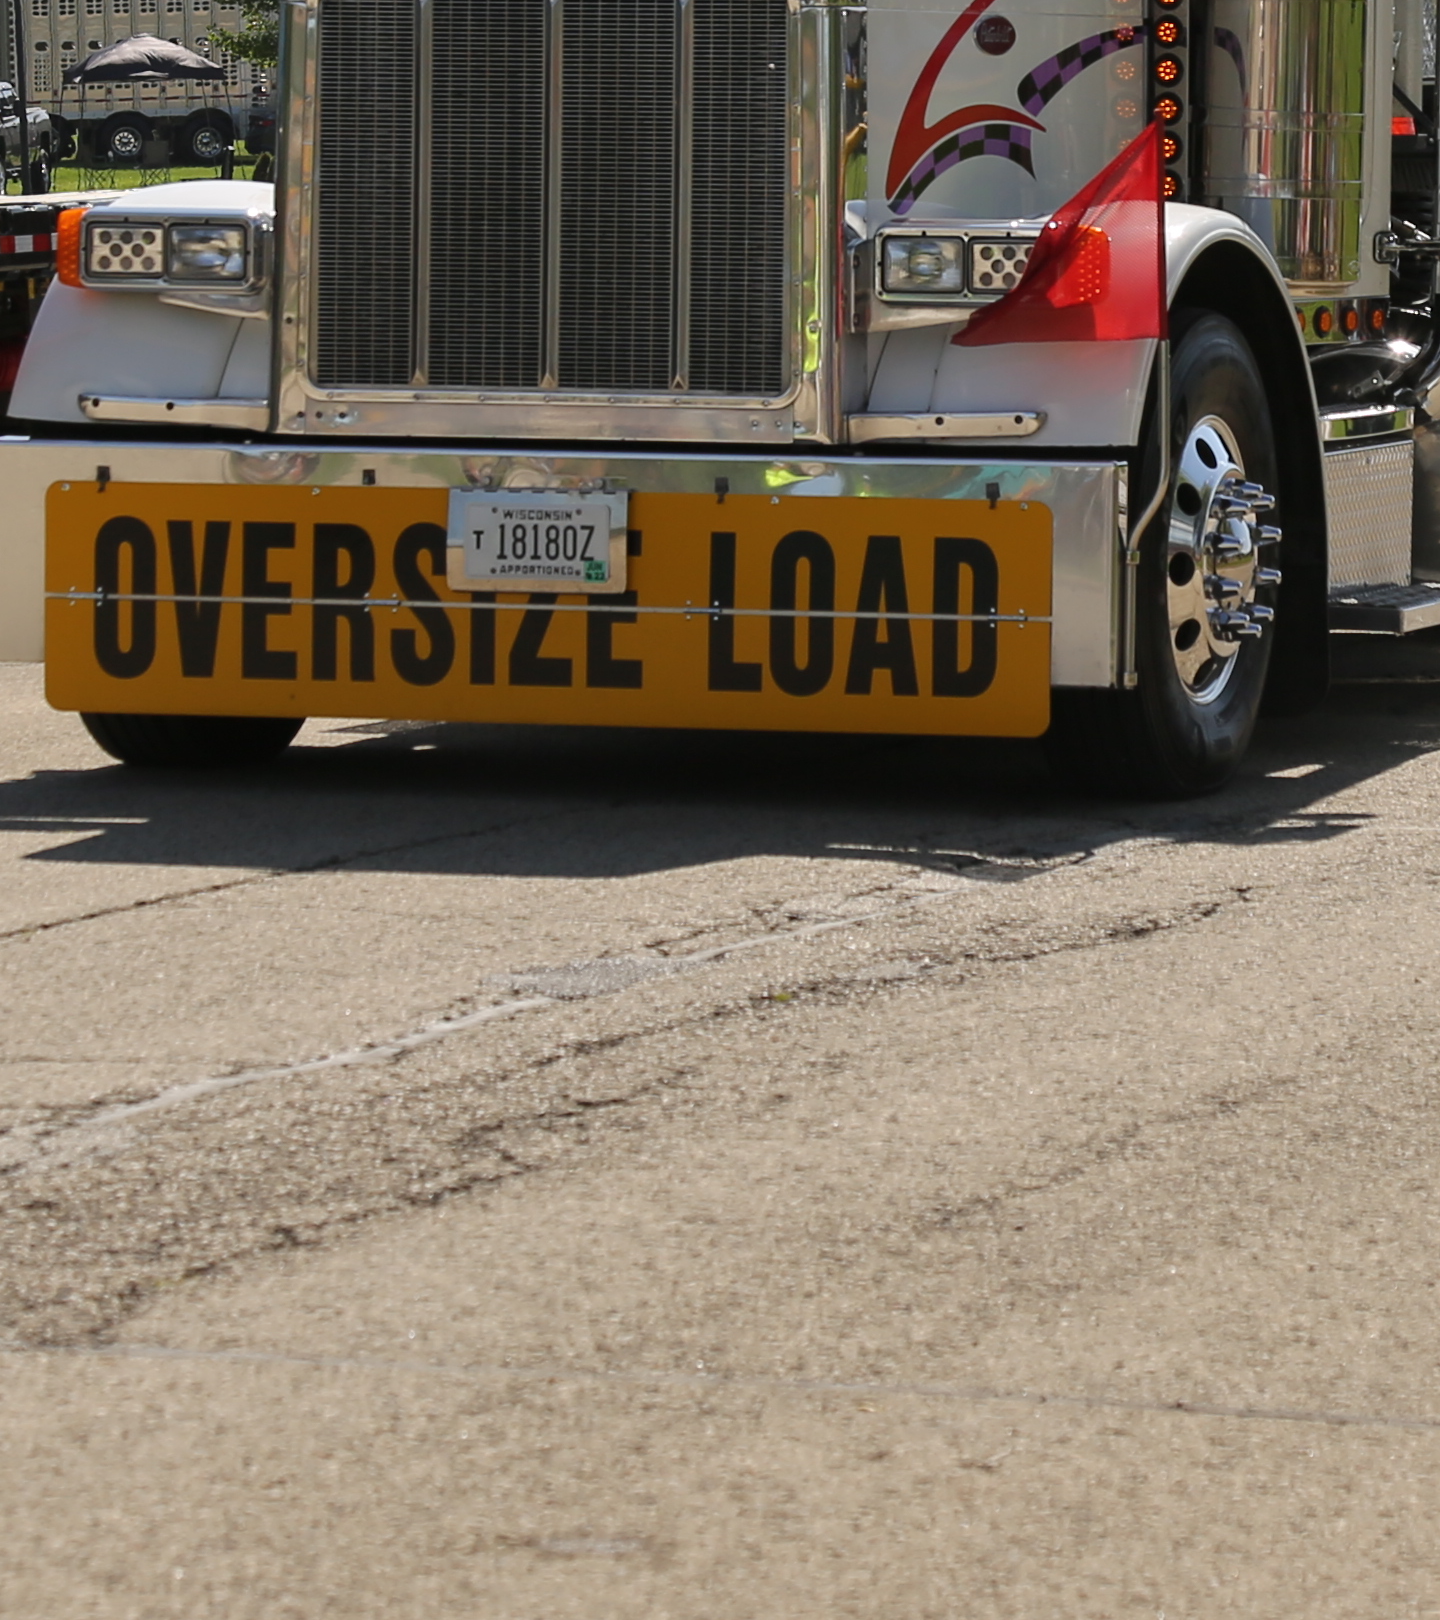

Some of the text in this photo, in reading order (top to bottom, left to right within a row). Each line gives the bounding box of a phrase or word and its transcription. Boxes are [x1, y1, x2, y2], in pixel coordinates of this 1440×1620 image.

[503, 509, 573, 521] WISCONSIN
[472, 523, 595, 561] T 18180Z
[499, 564, 574, 576] APPORTIONED
[93, 515, 999, 698] OVERSIZE LOAD
